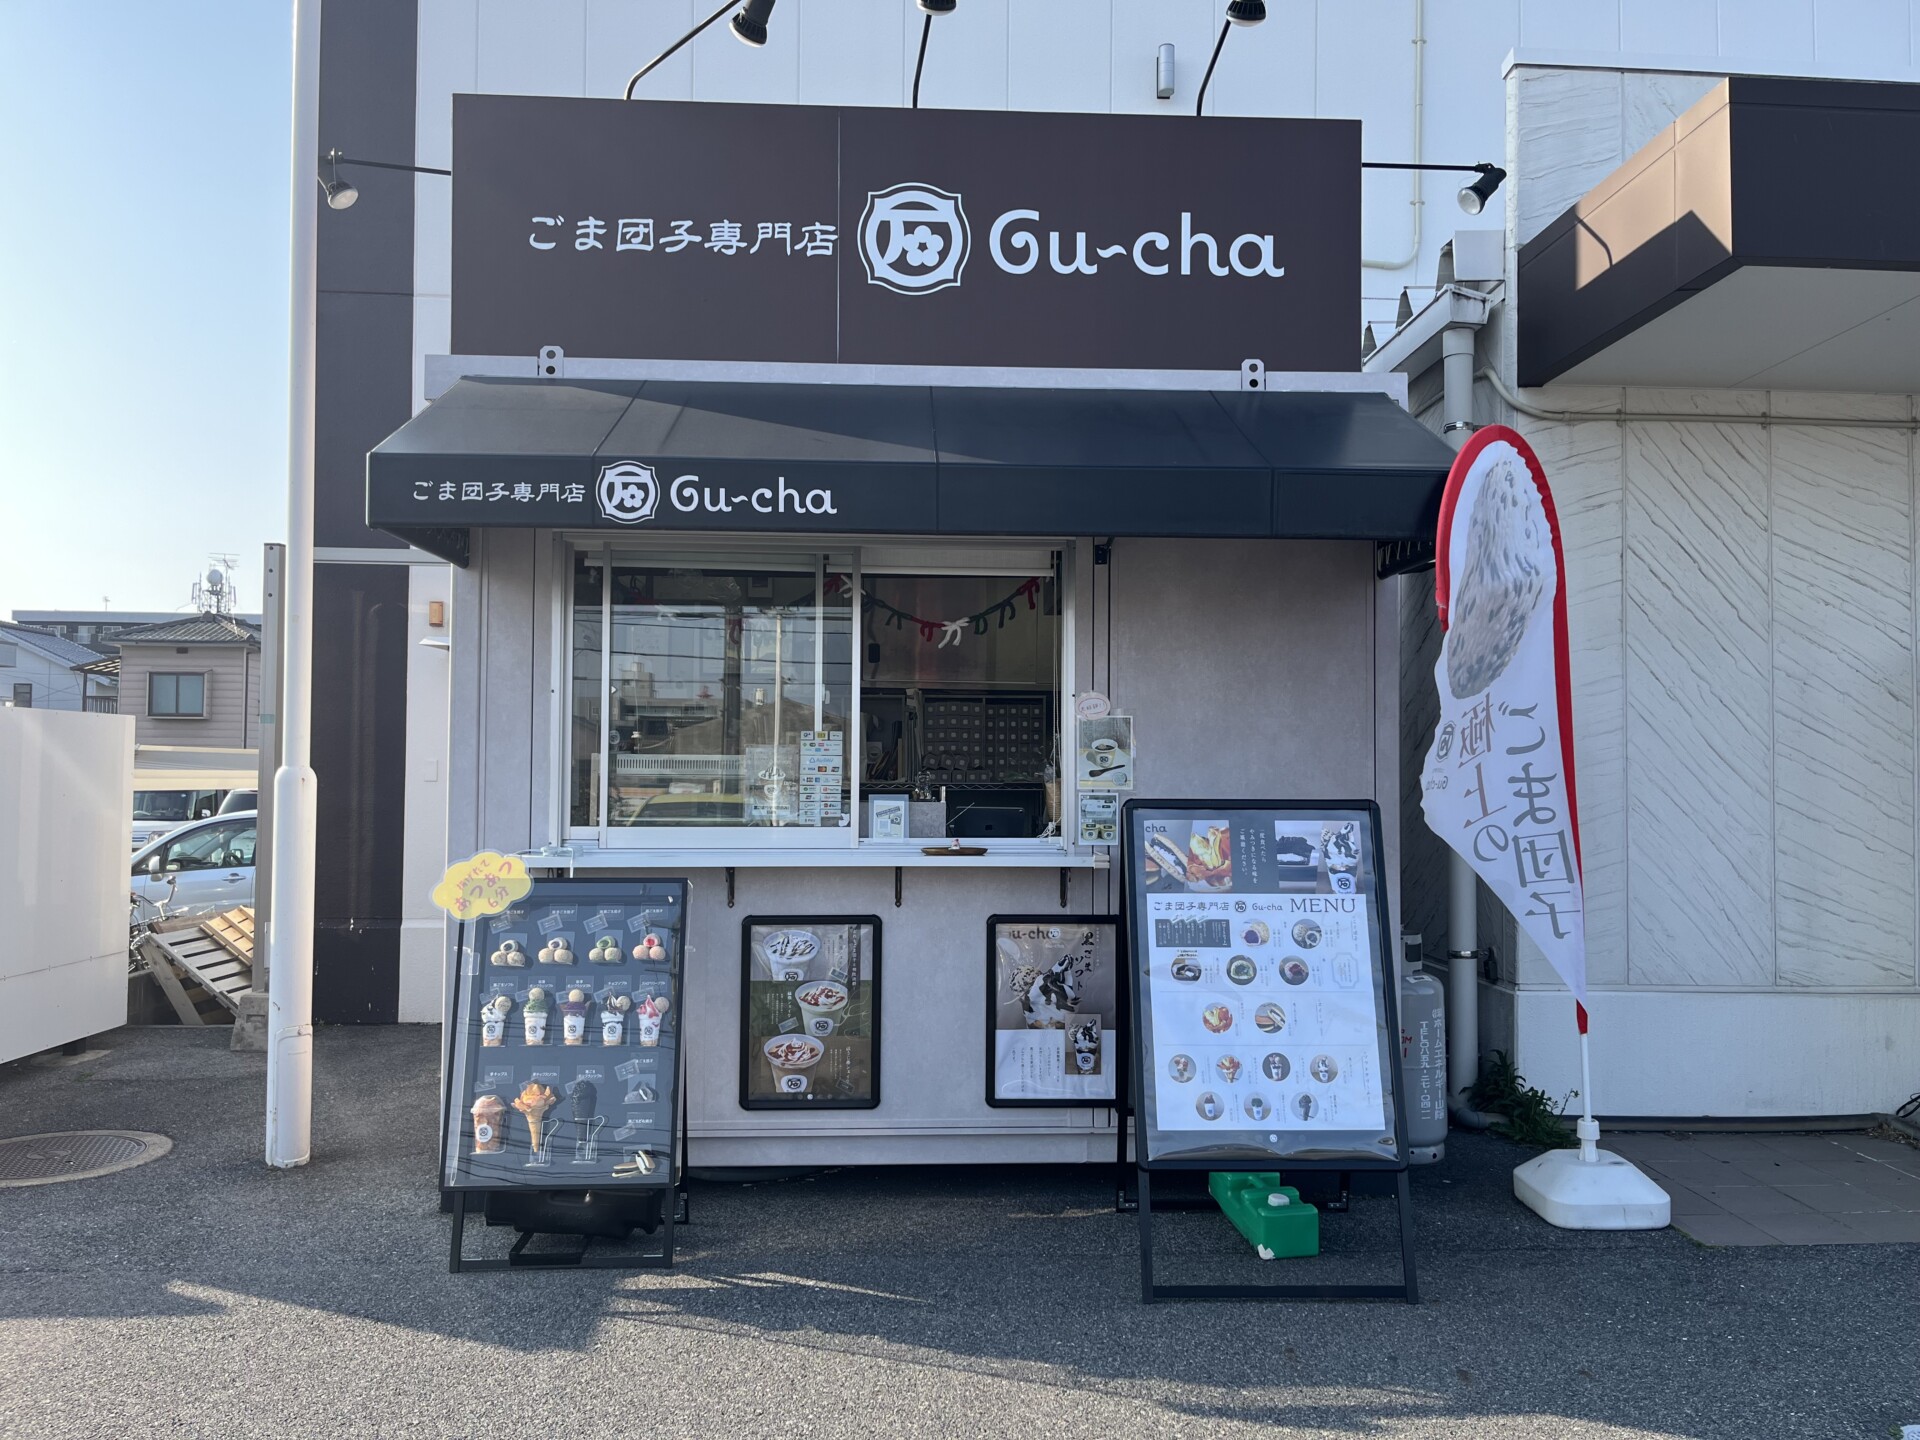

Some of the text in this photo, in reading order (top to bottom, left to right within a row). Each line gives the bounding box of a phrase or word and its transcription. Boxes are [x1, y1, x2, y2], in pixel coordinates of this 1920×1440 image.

[529, 215, 837, 258] ごま団子専門店
[412, 480, 586, 503] ごま団子専門店
[1145, 823, 1168, 833] cha
[1154, 901, 1230, 911] ごま団子専門店
[1290, 898, 1356, 913] MENU
